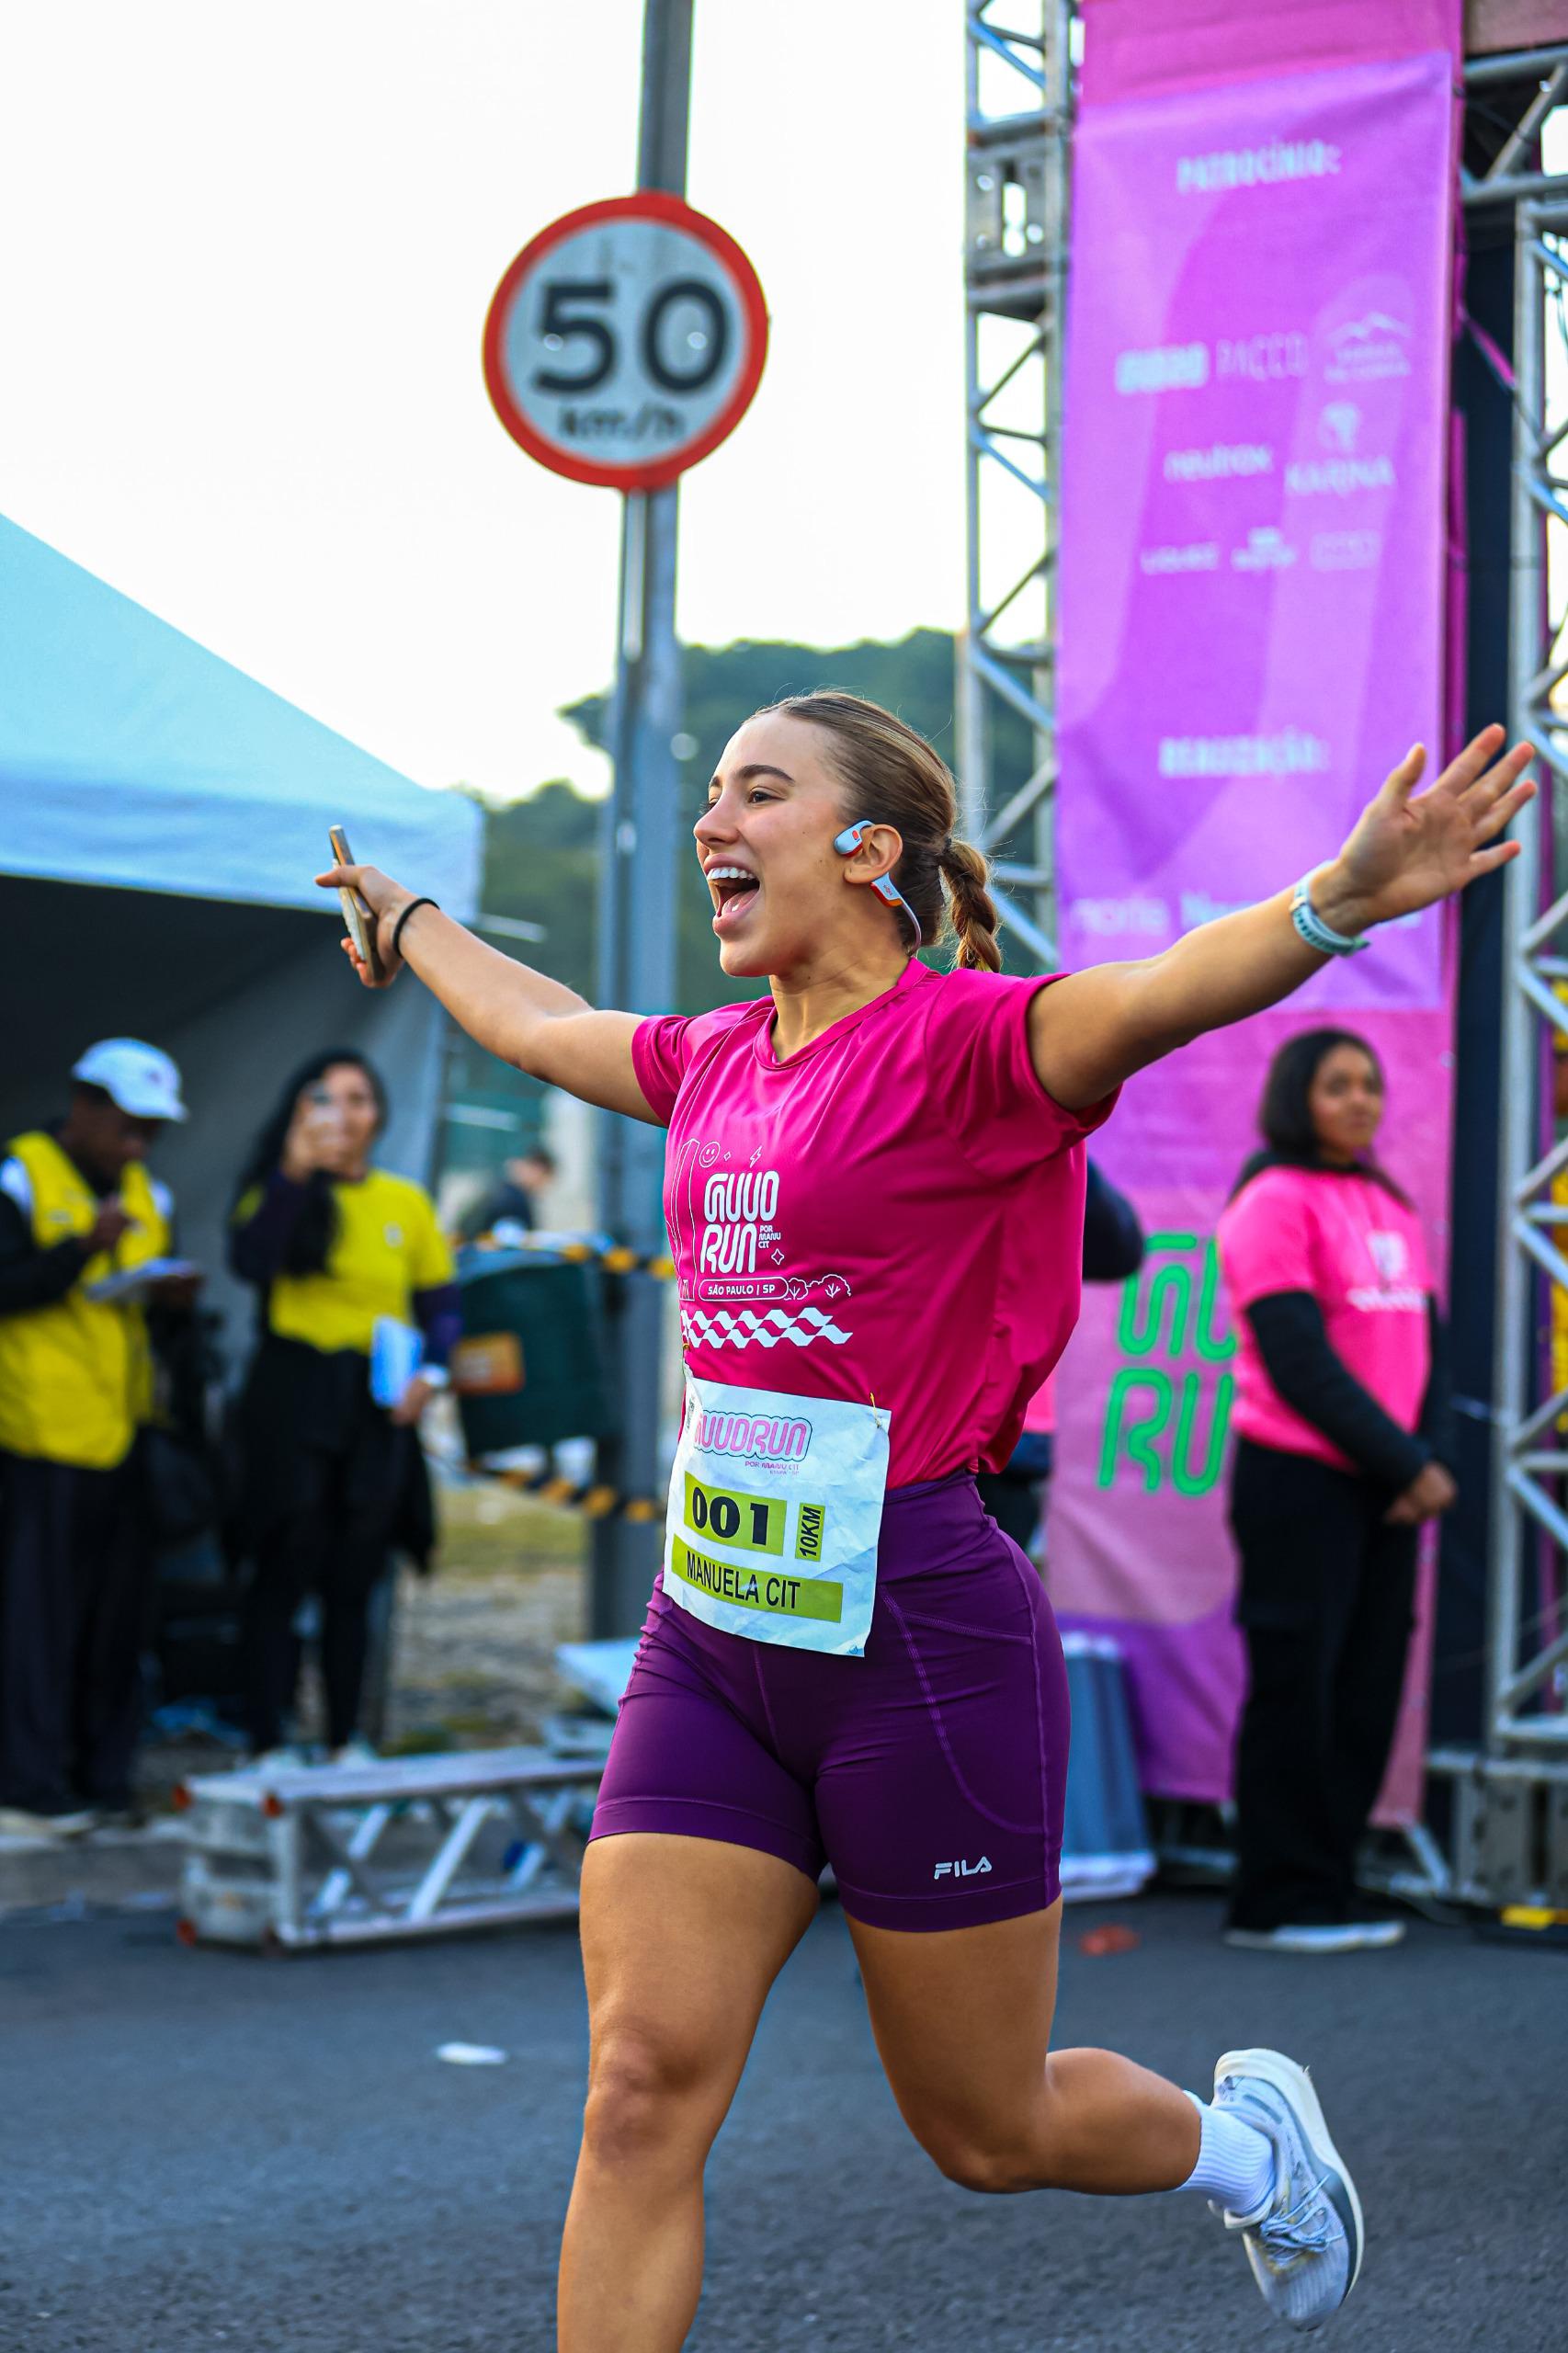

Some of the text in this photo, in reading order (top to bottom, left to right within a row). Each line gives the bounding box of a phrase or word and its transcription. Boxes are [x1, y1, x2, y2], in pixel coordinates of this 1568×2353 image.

[531, 278, 730, 397] 50
[699, 1222, 757, 1274] RUN
[707, 1284, 724, 1296] SÃO
[726, 1284, 755, 1296] PAULO
[762, 1284, 776, 1294] SP
[692, 1486, 822, 1557] 001 10KM
[687, 1550, 801, 1609] MANUELA CIT
[934, 1856, 993, 1880] FILA
